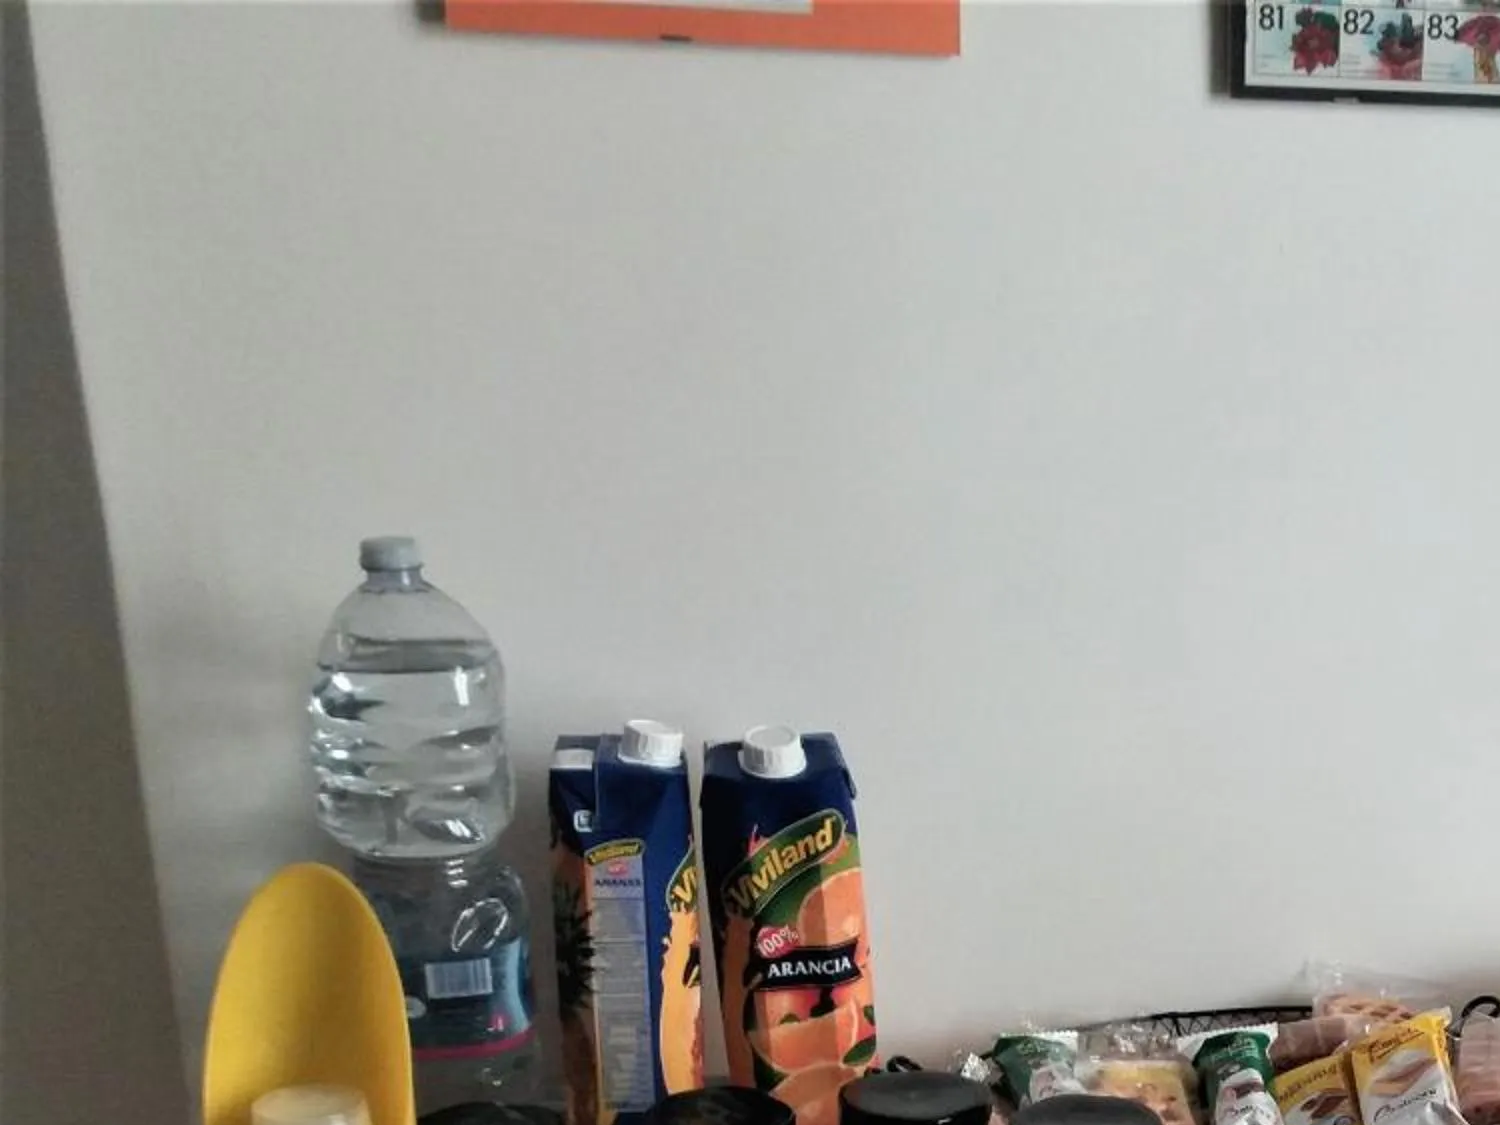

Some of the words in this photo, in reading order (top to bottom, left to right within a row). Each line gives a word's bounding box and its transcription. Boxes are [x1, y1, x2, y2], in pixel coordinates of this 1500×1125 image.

[1258, 5, 1285, 30] 81
[1343, 9, 1375, 35] 82
[1427, 14, 1458, 40] 83
[728, 815, 837, 909] Viviland
[758, 924, 799, 957] 100%
[767, 956, 853, 979] ARANCIA
